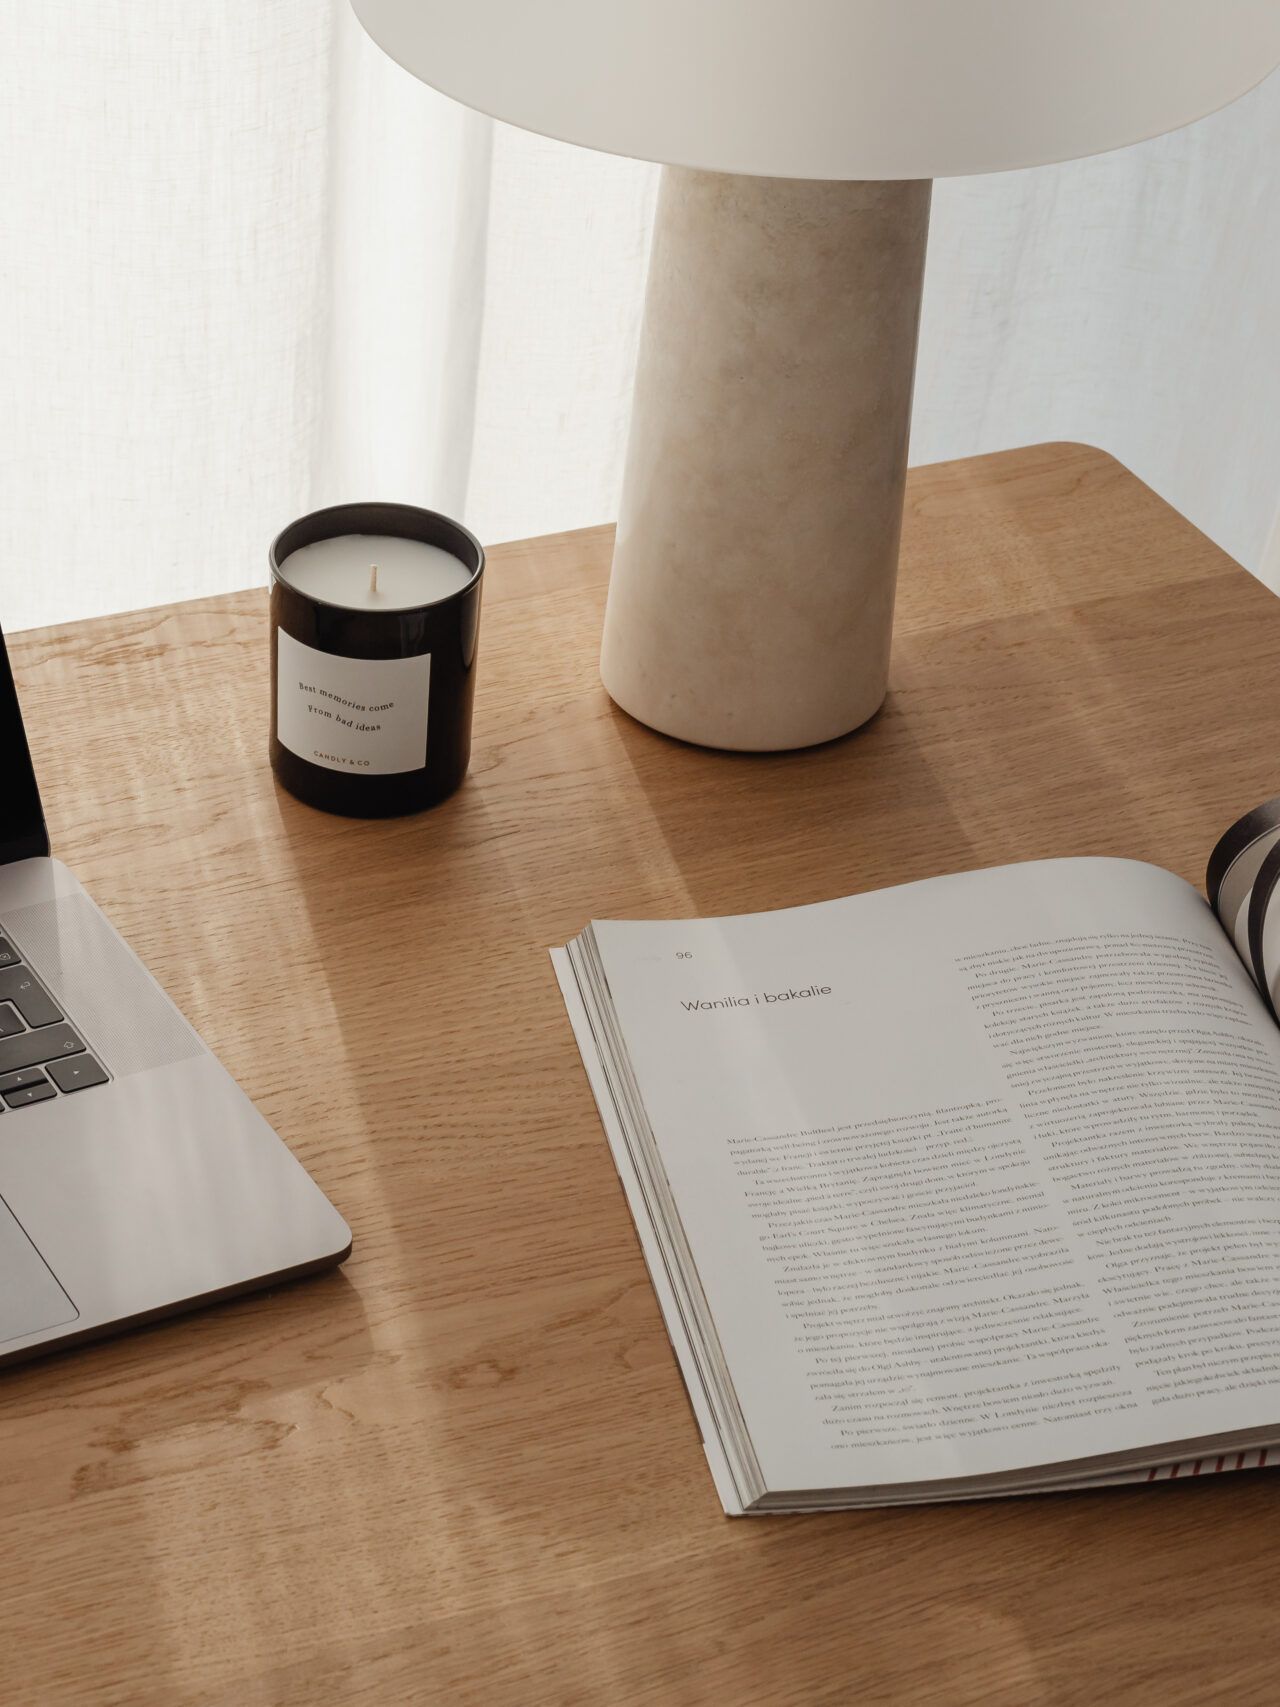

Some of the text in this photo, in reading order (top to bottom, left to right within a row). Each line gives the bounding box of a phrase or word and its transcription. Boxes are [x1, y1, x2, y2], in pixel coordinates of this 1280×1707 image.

[299, 682, 395, 712] Best memories come
[335, 714, 353, 728] bad
[356, 722, 381, 732] ideas
[313, 750, 347, 764] CANDLY
[675, 951, 693, 960] 96
[680, 985, 832, 1012] Wanilia i bakalie
